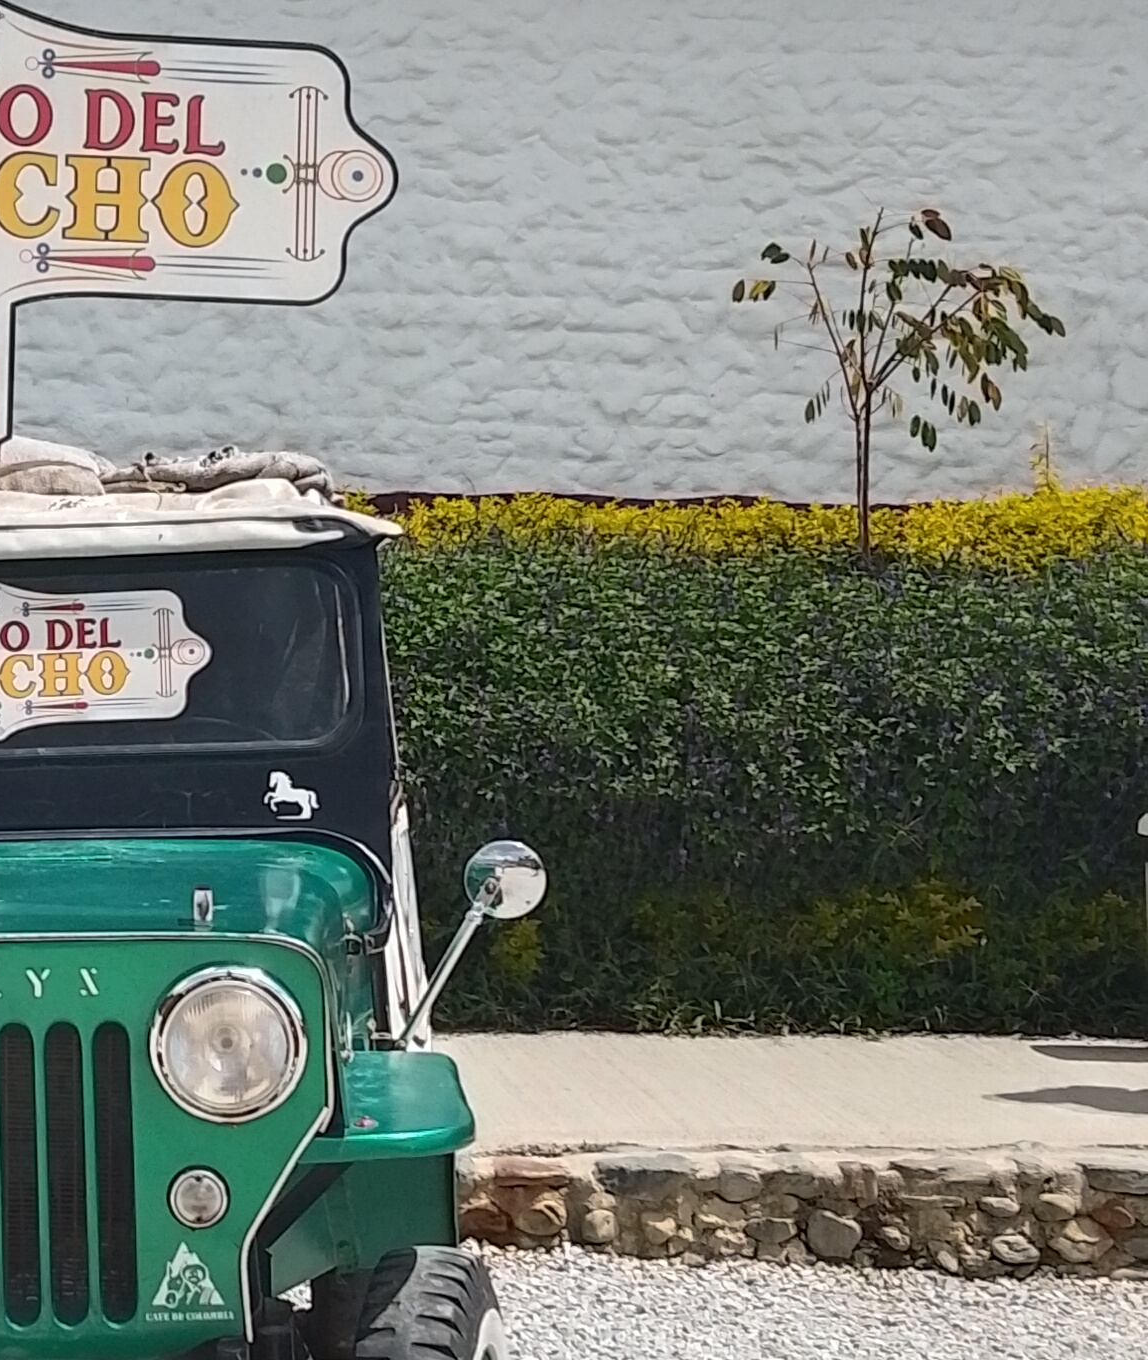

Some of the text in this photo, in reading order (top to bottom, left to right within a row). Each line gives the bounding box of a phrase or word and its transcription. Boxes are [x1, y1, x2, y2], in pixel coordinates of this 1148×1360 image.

[85, 88, 227, 156] DEL
[46, 618, 121, 649] DEL
[185, 1310, 235, 1321] COLOMBIA
